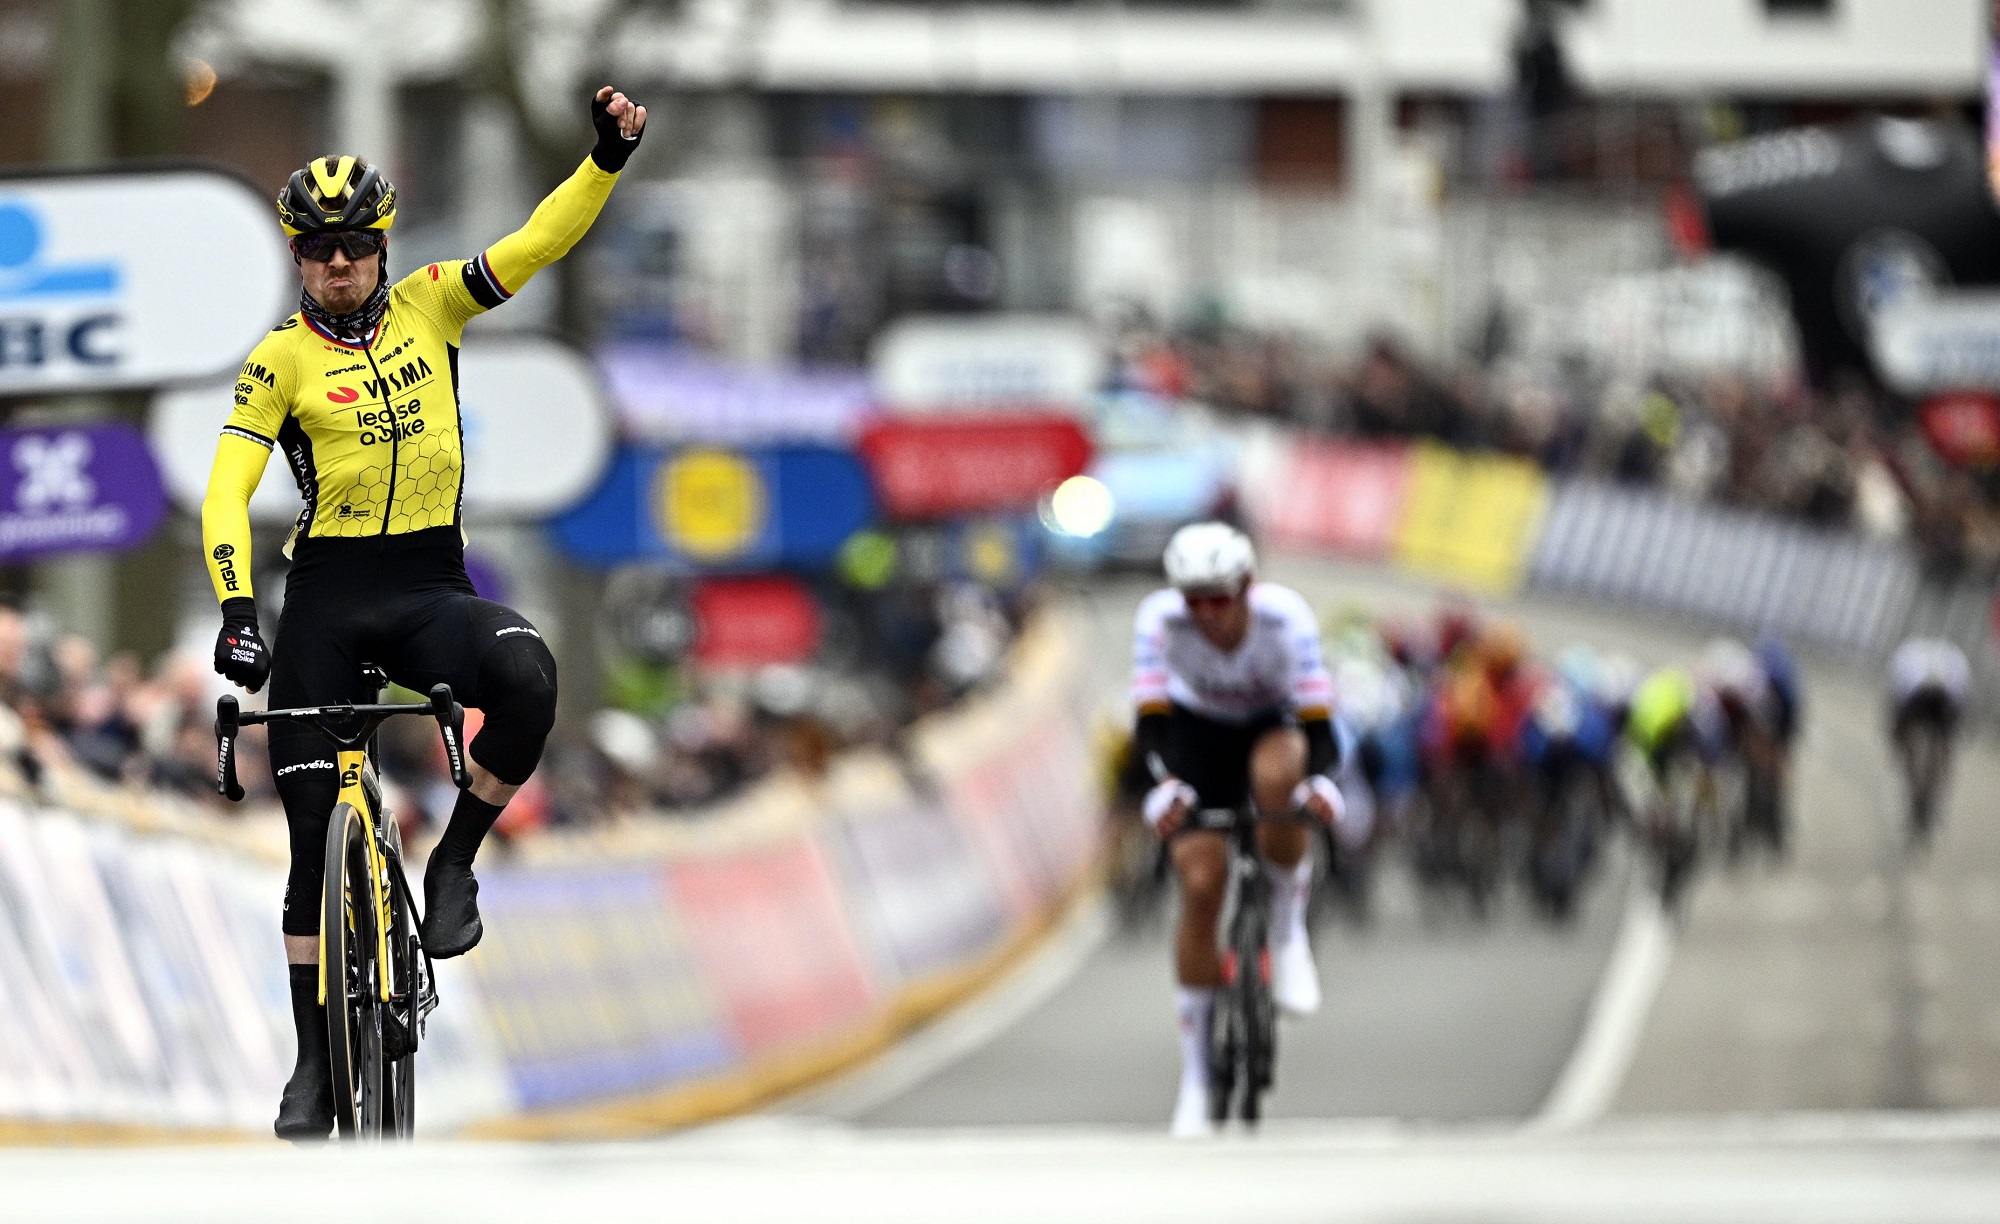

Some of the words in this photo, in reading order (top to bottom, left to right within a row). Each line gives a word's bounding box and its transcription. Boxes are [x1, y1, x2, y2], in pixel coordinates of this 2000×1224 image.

[0, 312, 124, 367] BC
[334, 347, 355, 357] VISMA
[379, 351, 396, 364] AGU
[325, 364, 367, 377] cervélo
[362, 356, 433, 399] VISMA
[356, 398, 421, 428] lease
[218, 559, 240, 592] AGU
[232, 647, 256, 658] lease
[239, 639, 263, 652] VISMA
[290, 708, 320, 716] cervél
[444, 725, 462, 771] SRAM
[217, 736, 230, 783] SRAM
[277, 759, 335, 777] cervélo
